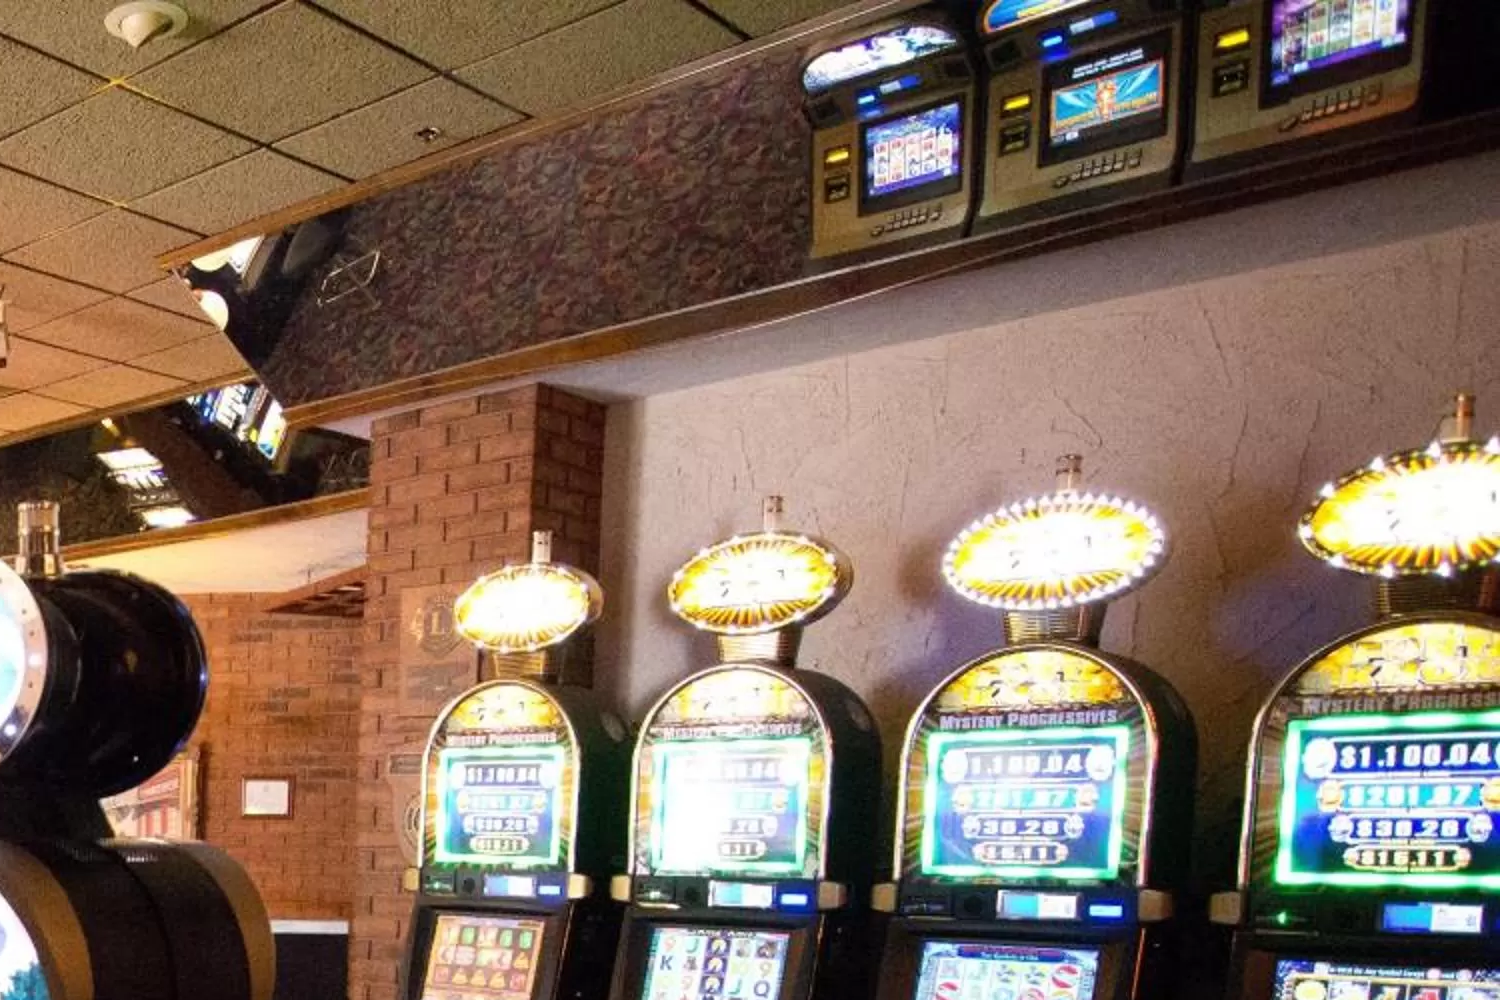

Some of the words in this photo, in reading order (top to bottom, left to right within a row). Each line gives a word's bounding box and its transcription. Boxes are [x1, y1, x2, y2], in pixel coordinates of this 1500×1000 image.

[940, 716, 1001, 729] MYSTERY
[1008, 710, 1117, 726] PROGRESSIVES
[660, 956, 673, 970] K
[753, 980, 770, 998] Q
